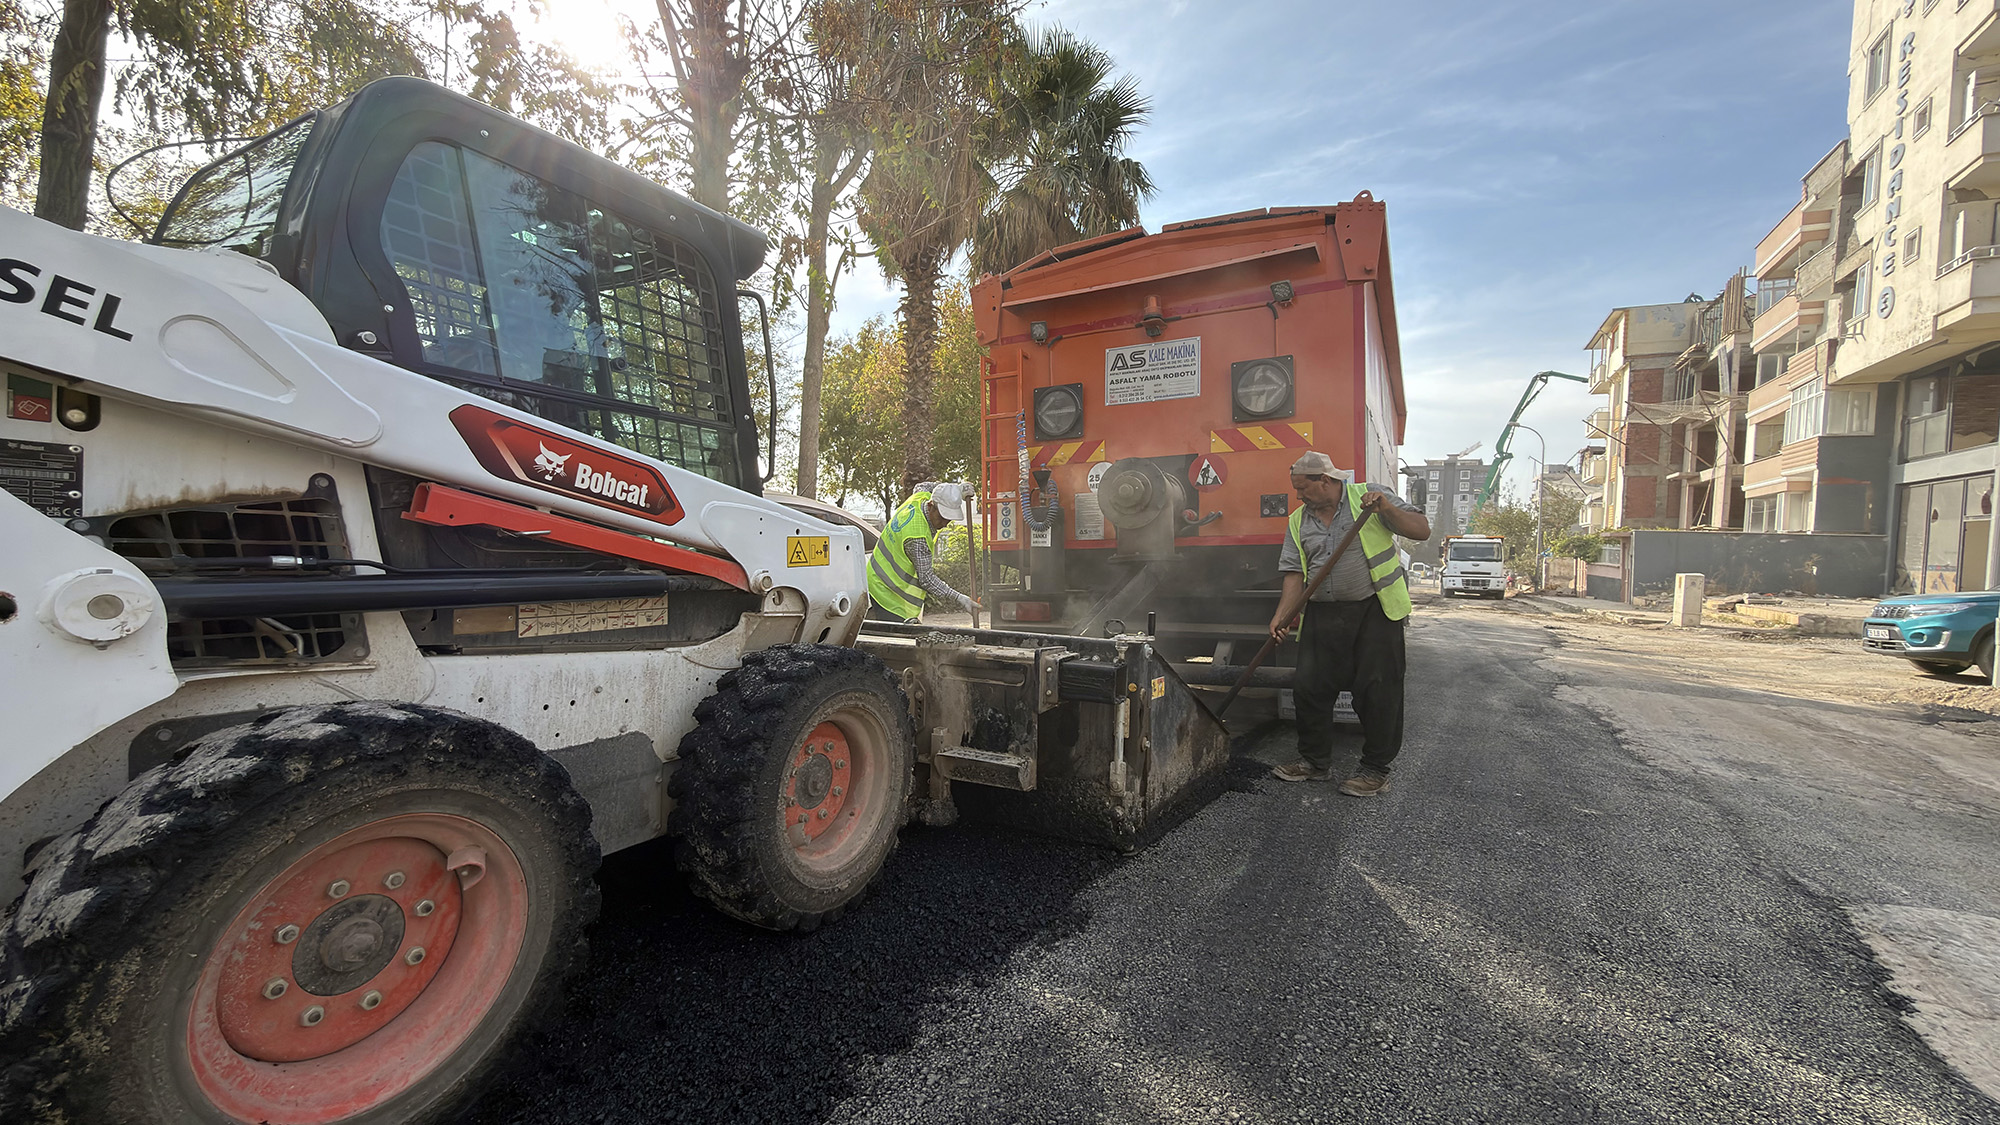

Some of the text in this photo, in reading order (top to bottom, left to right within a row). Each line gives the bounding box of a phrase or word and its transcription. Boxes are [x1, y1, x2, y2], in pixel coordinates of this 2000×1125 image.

[1110, 342, 1196, 372] AS KALE MAKİNA
[1109, 370, 1196, 386] ASFALT YAMA ROBOTU
[574, 462, 649, 508] Bobcat
